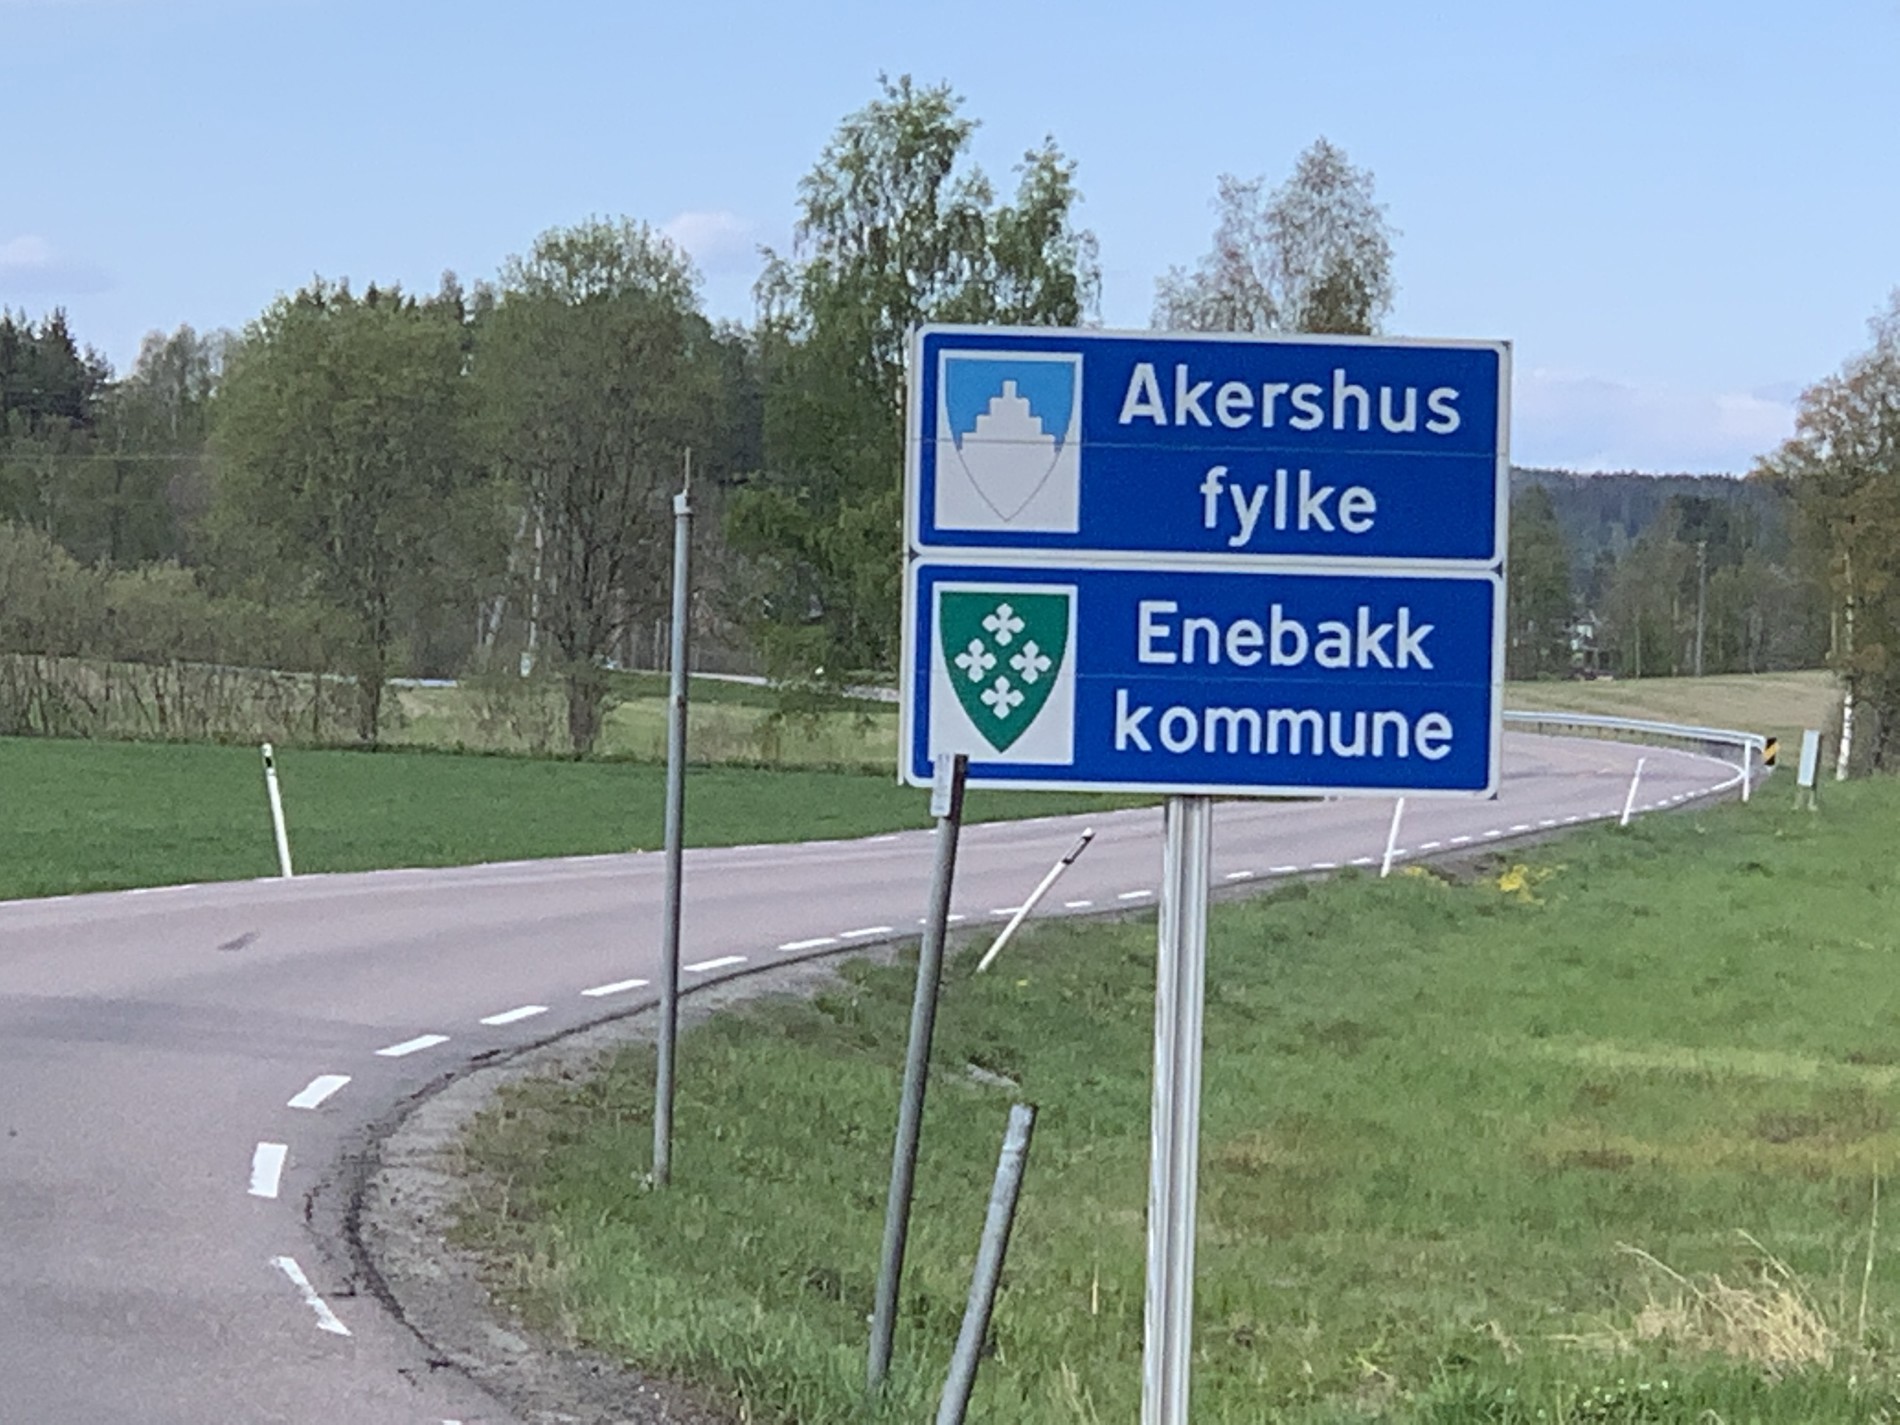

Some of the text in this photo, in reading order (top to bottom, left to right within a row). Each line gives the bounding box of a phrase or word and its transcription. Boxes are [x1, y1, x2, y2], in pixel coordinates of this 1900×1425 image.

[1119, 363, 1460, 433] Akershus
[1200, 466, 1376, 547] fylke
[1138, 601, 1434, 669] Enebakk
[1115, 689, 1453, 760] kommune
